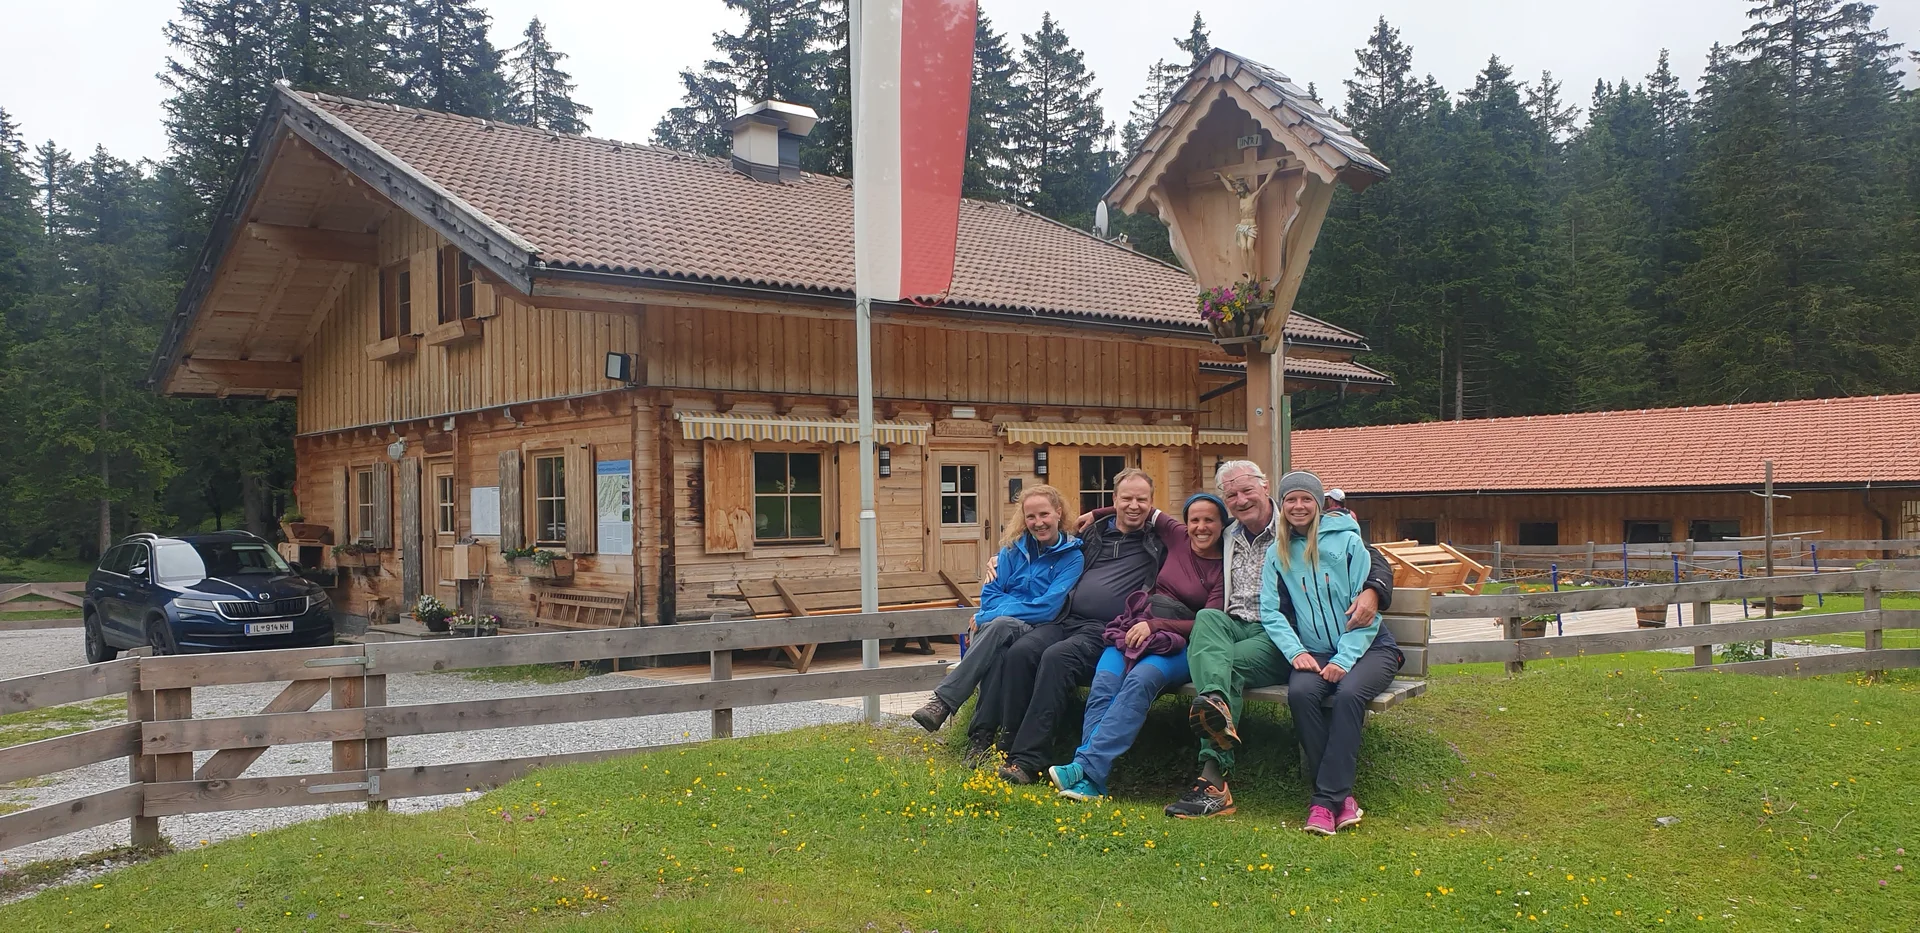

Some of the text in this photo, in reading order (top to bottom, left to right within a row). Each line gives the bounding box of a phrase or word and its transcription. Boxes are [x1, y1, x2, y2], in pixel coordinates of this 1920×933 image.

[253, 623, 289, 633] IL 914 NH
